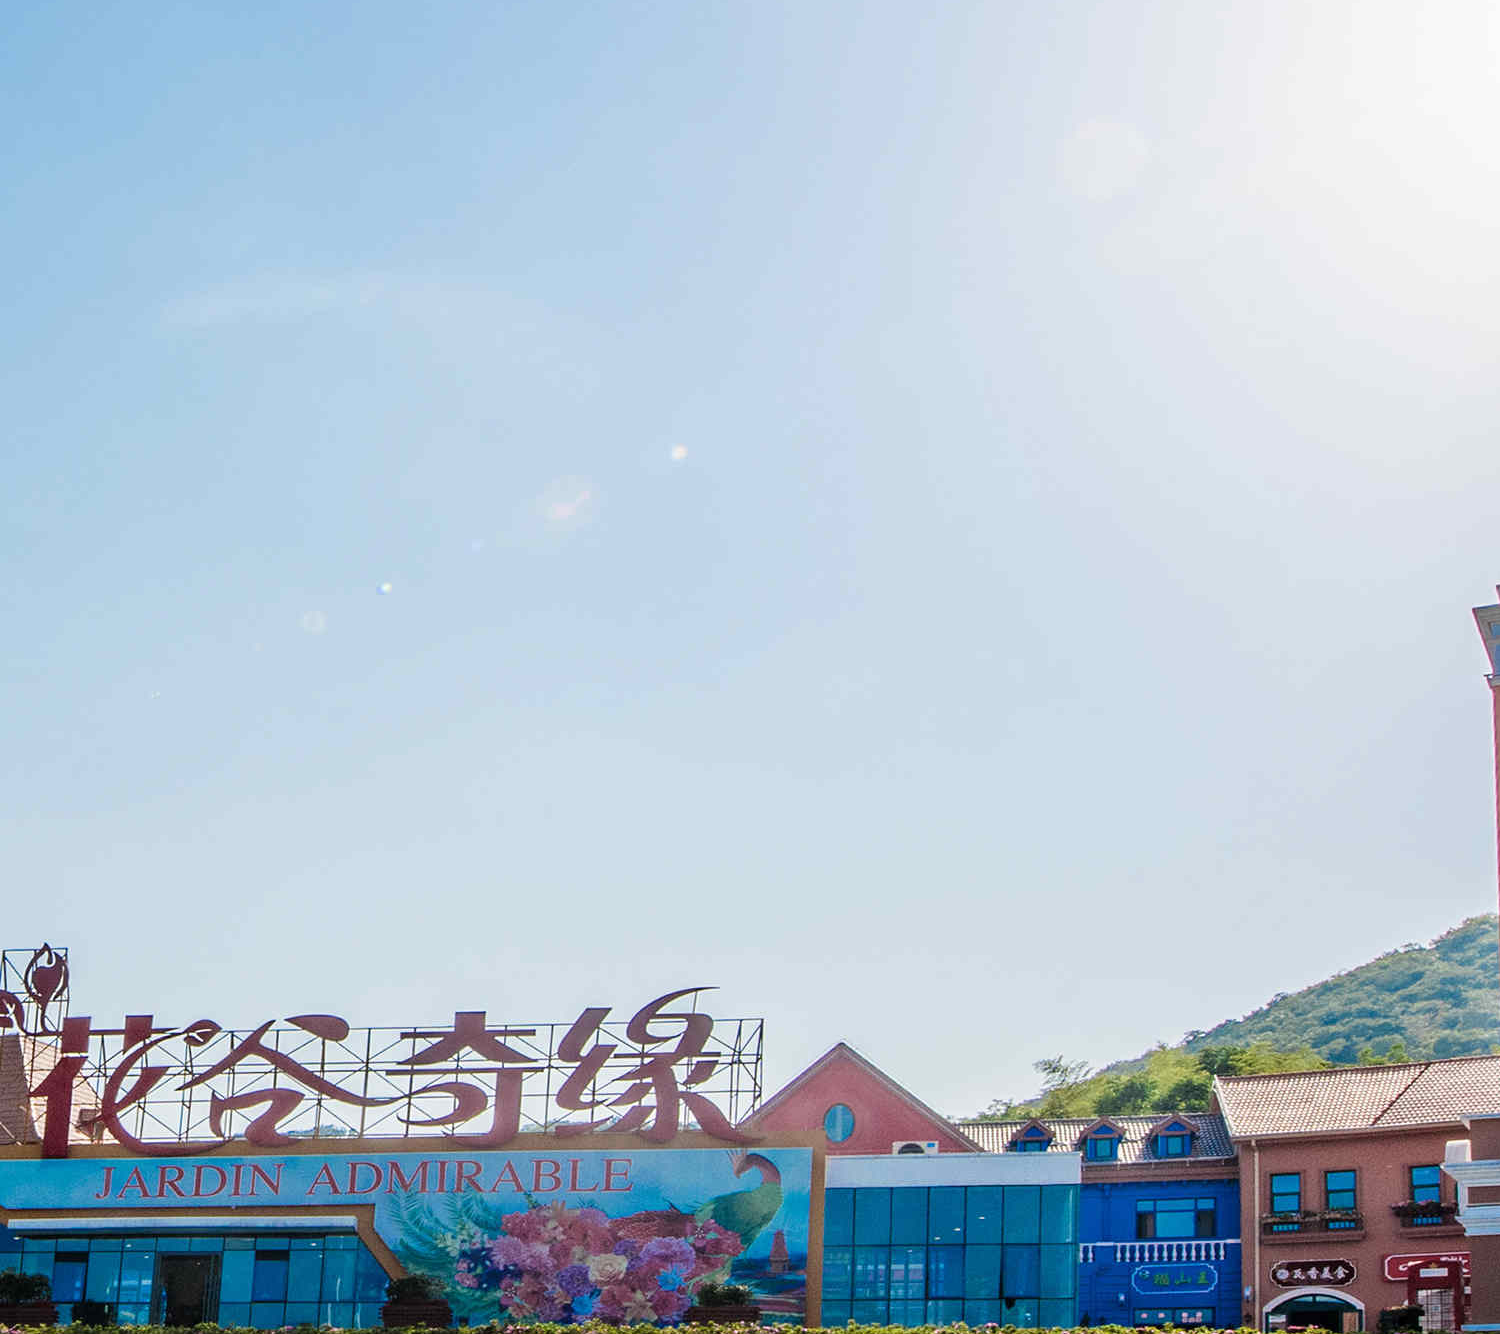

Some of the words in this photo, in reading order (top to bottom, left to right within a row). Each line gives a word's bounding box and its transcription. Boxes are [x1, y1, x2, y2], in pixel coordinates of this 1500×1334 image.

[26, 986, 764, 1159] 花谷奇缘
[95, 1162, 287, 1199] JARDIN
[305, 1157, 635, 1196] ADMIRABLE
